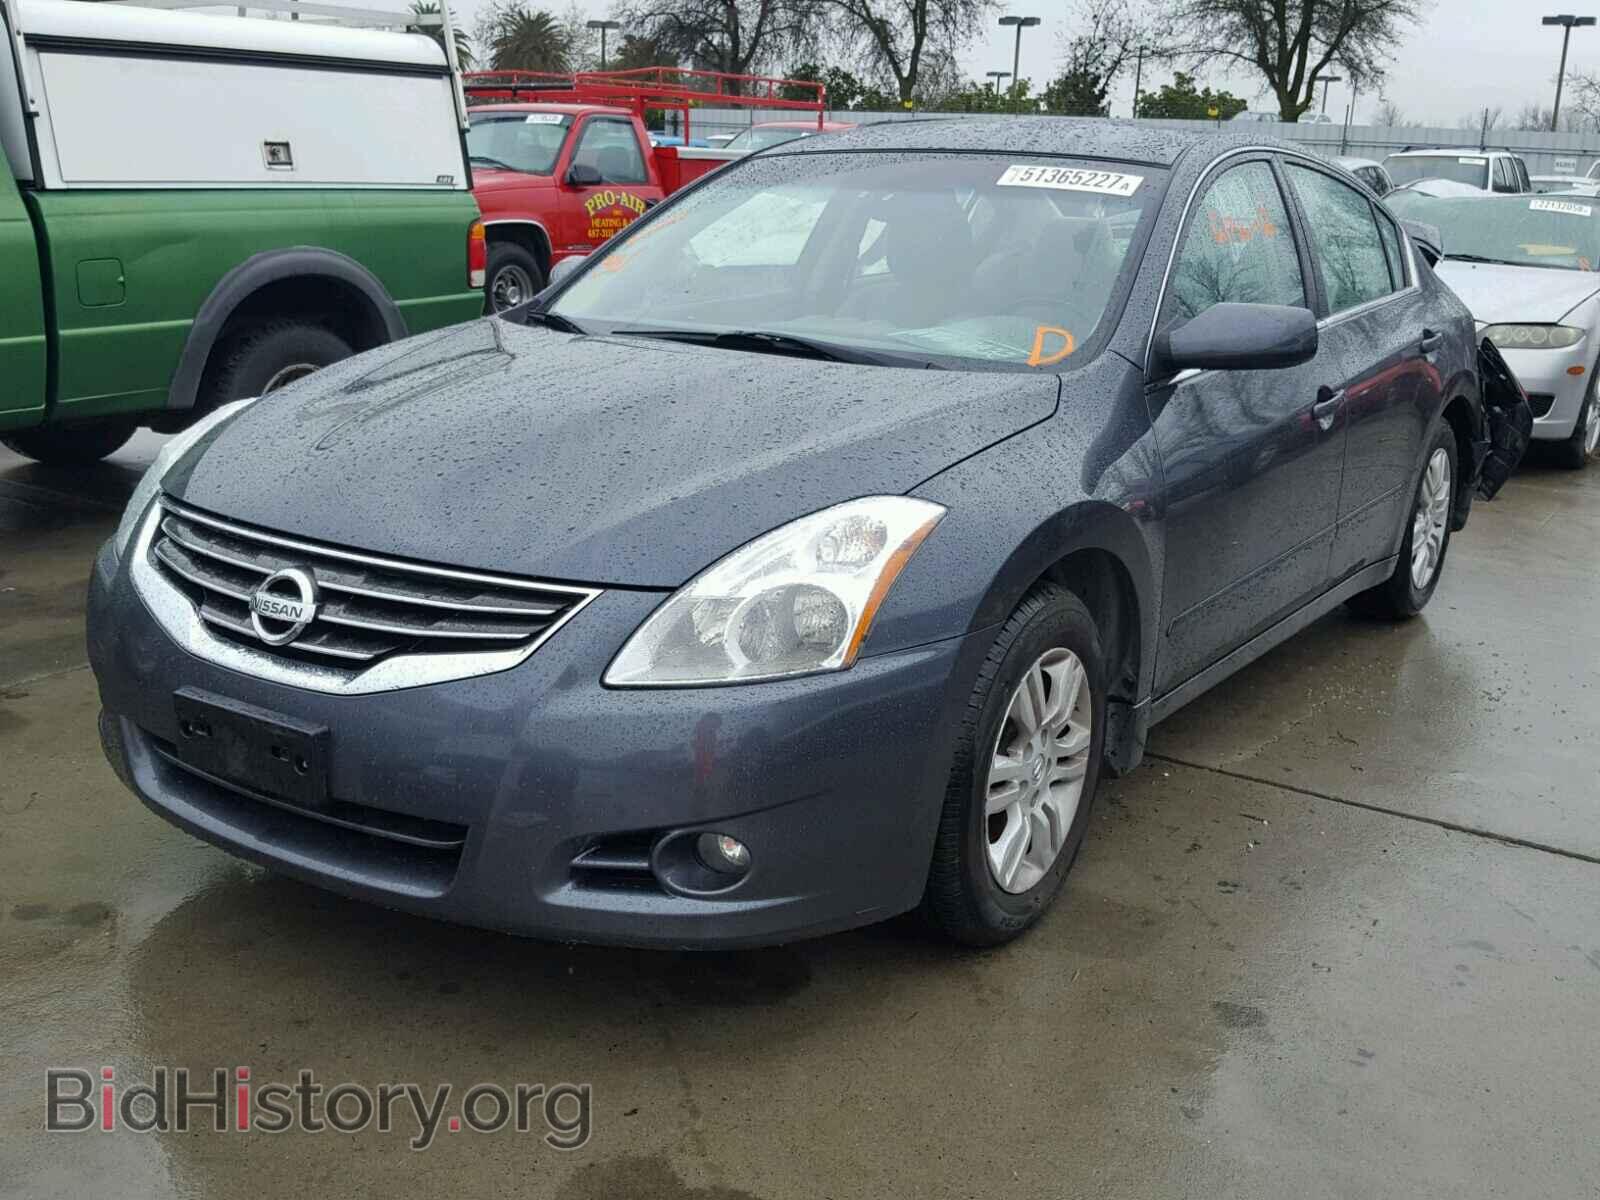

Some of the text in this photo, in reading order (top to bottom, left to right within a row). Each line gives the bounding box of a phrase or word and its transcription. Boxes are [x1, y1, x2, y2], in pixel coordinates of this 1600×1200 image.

[584, 190, 646, 216] PRO-AIR
[591, 218, 622, 228] HEATING
[1024, 326, 1073, 367] D
[252, 596, 304, 619] NISSAN
